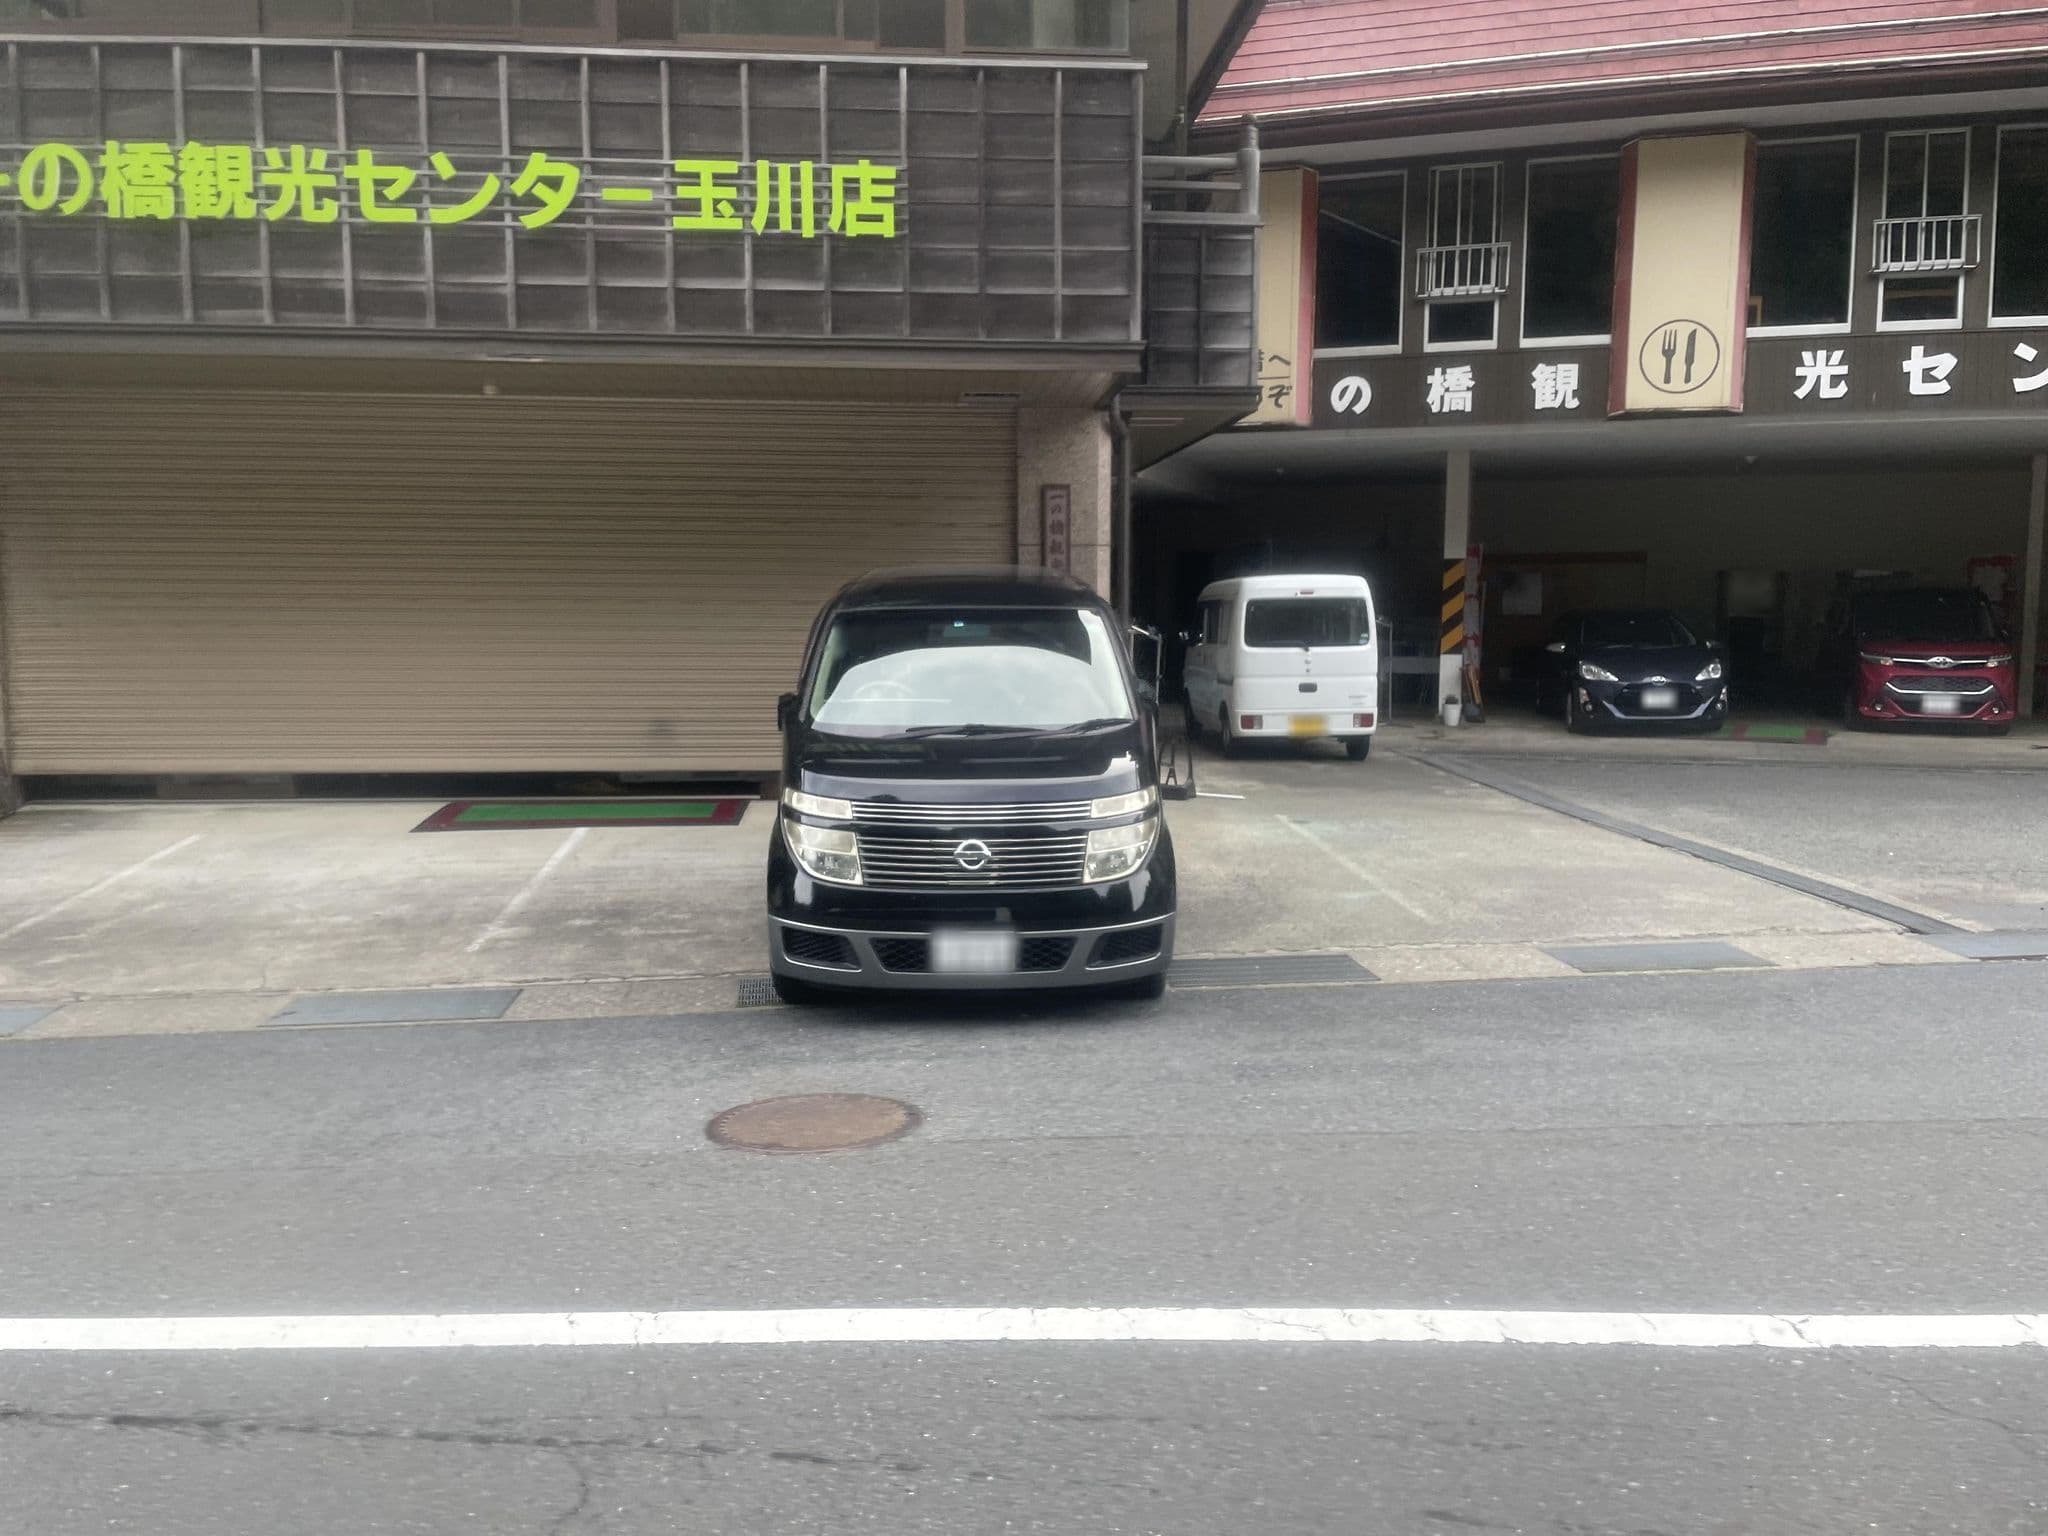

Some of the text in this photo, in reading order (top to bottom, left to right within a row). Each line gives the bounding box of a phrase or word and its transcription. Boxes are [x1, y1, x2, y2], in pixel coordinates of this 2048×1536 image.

[0, 140, 897, 238] の橋観光センター玉川店
[1258, 349, 1291, 373] へ
[1257, 384, 1293, 409] ぞ
